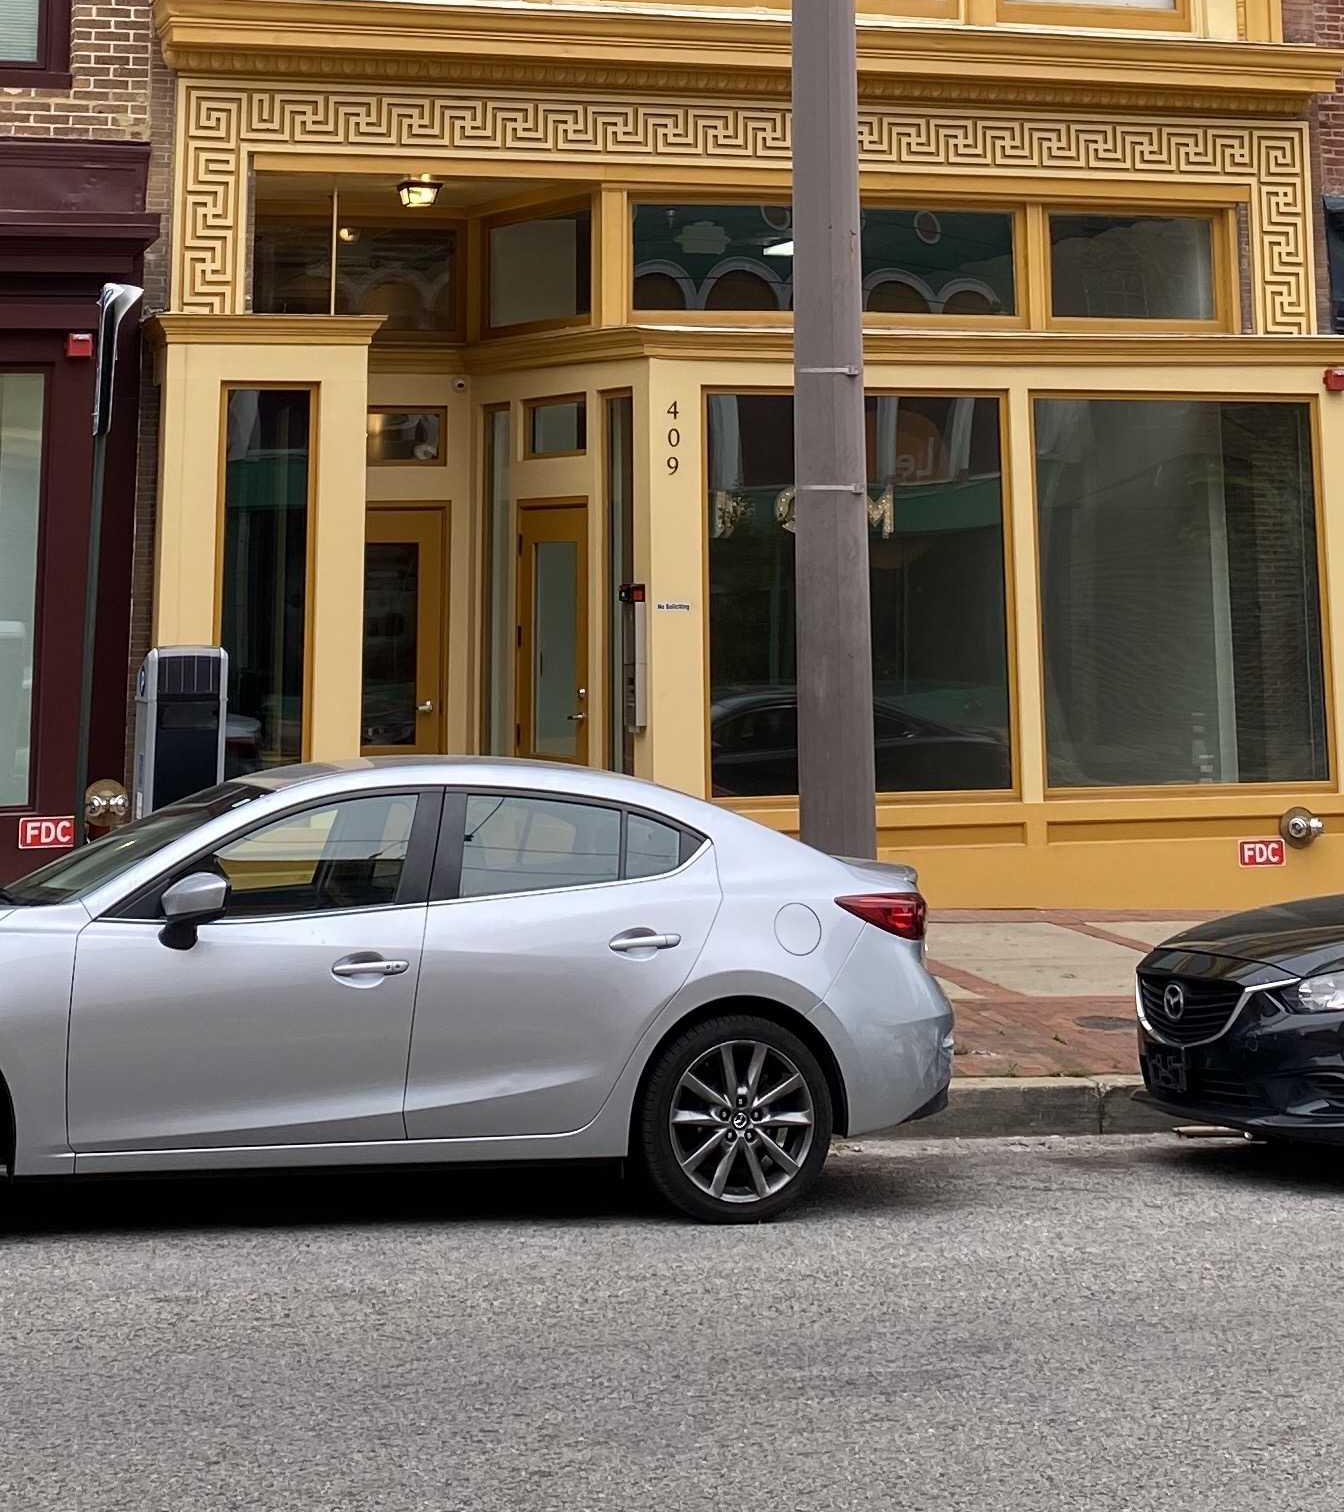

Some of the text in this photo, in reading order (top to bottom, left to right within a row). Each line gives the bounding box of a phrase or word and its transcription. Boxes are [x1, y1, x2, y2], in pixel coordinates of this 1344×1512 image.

[667, 400, 681, 476] 409
[26, 820, 72, 844] FDC
[1244, 842, 1280, 864] FDC
